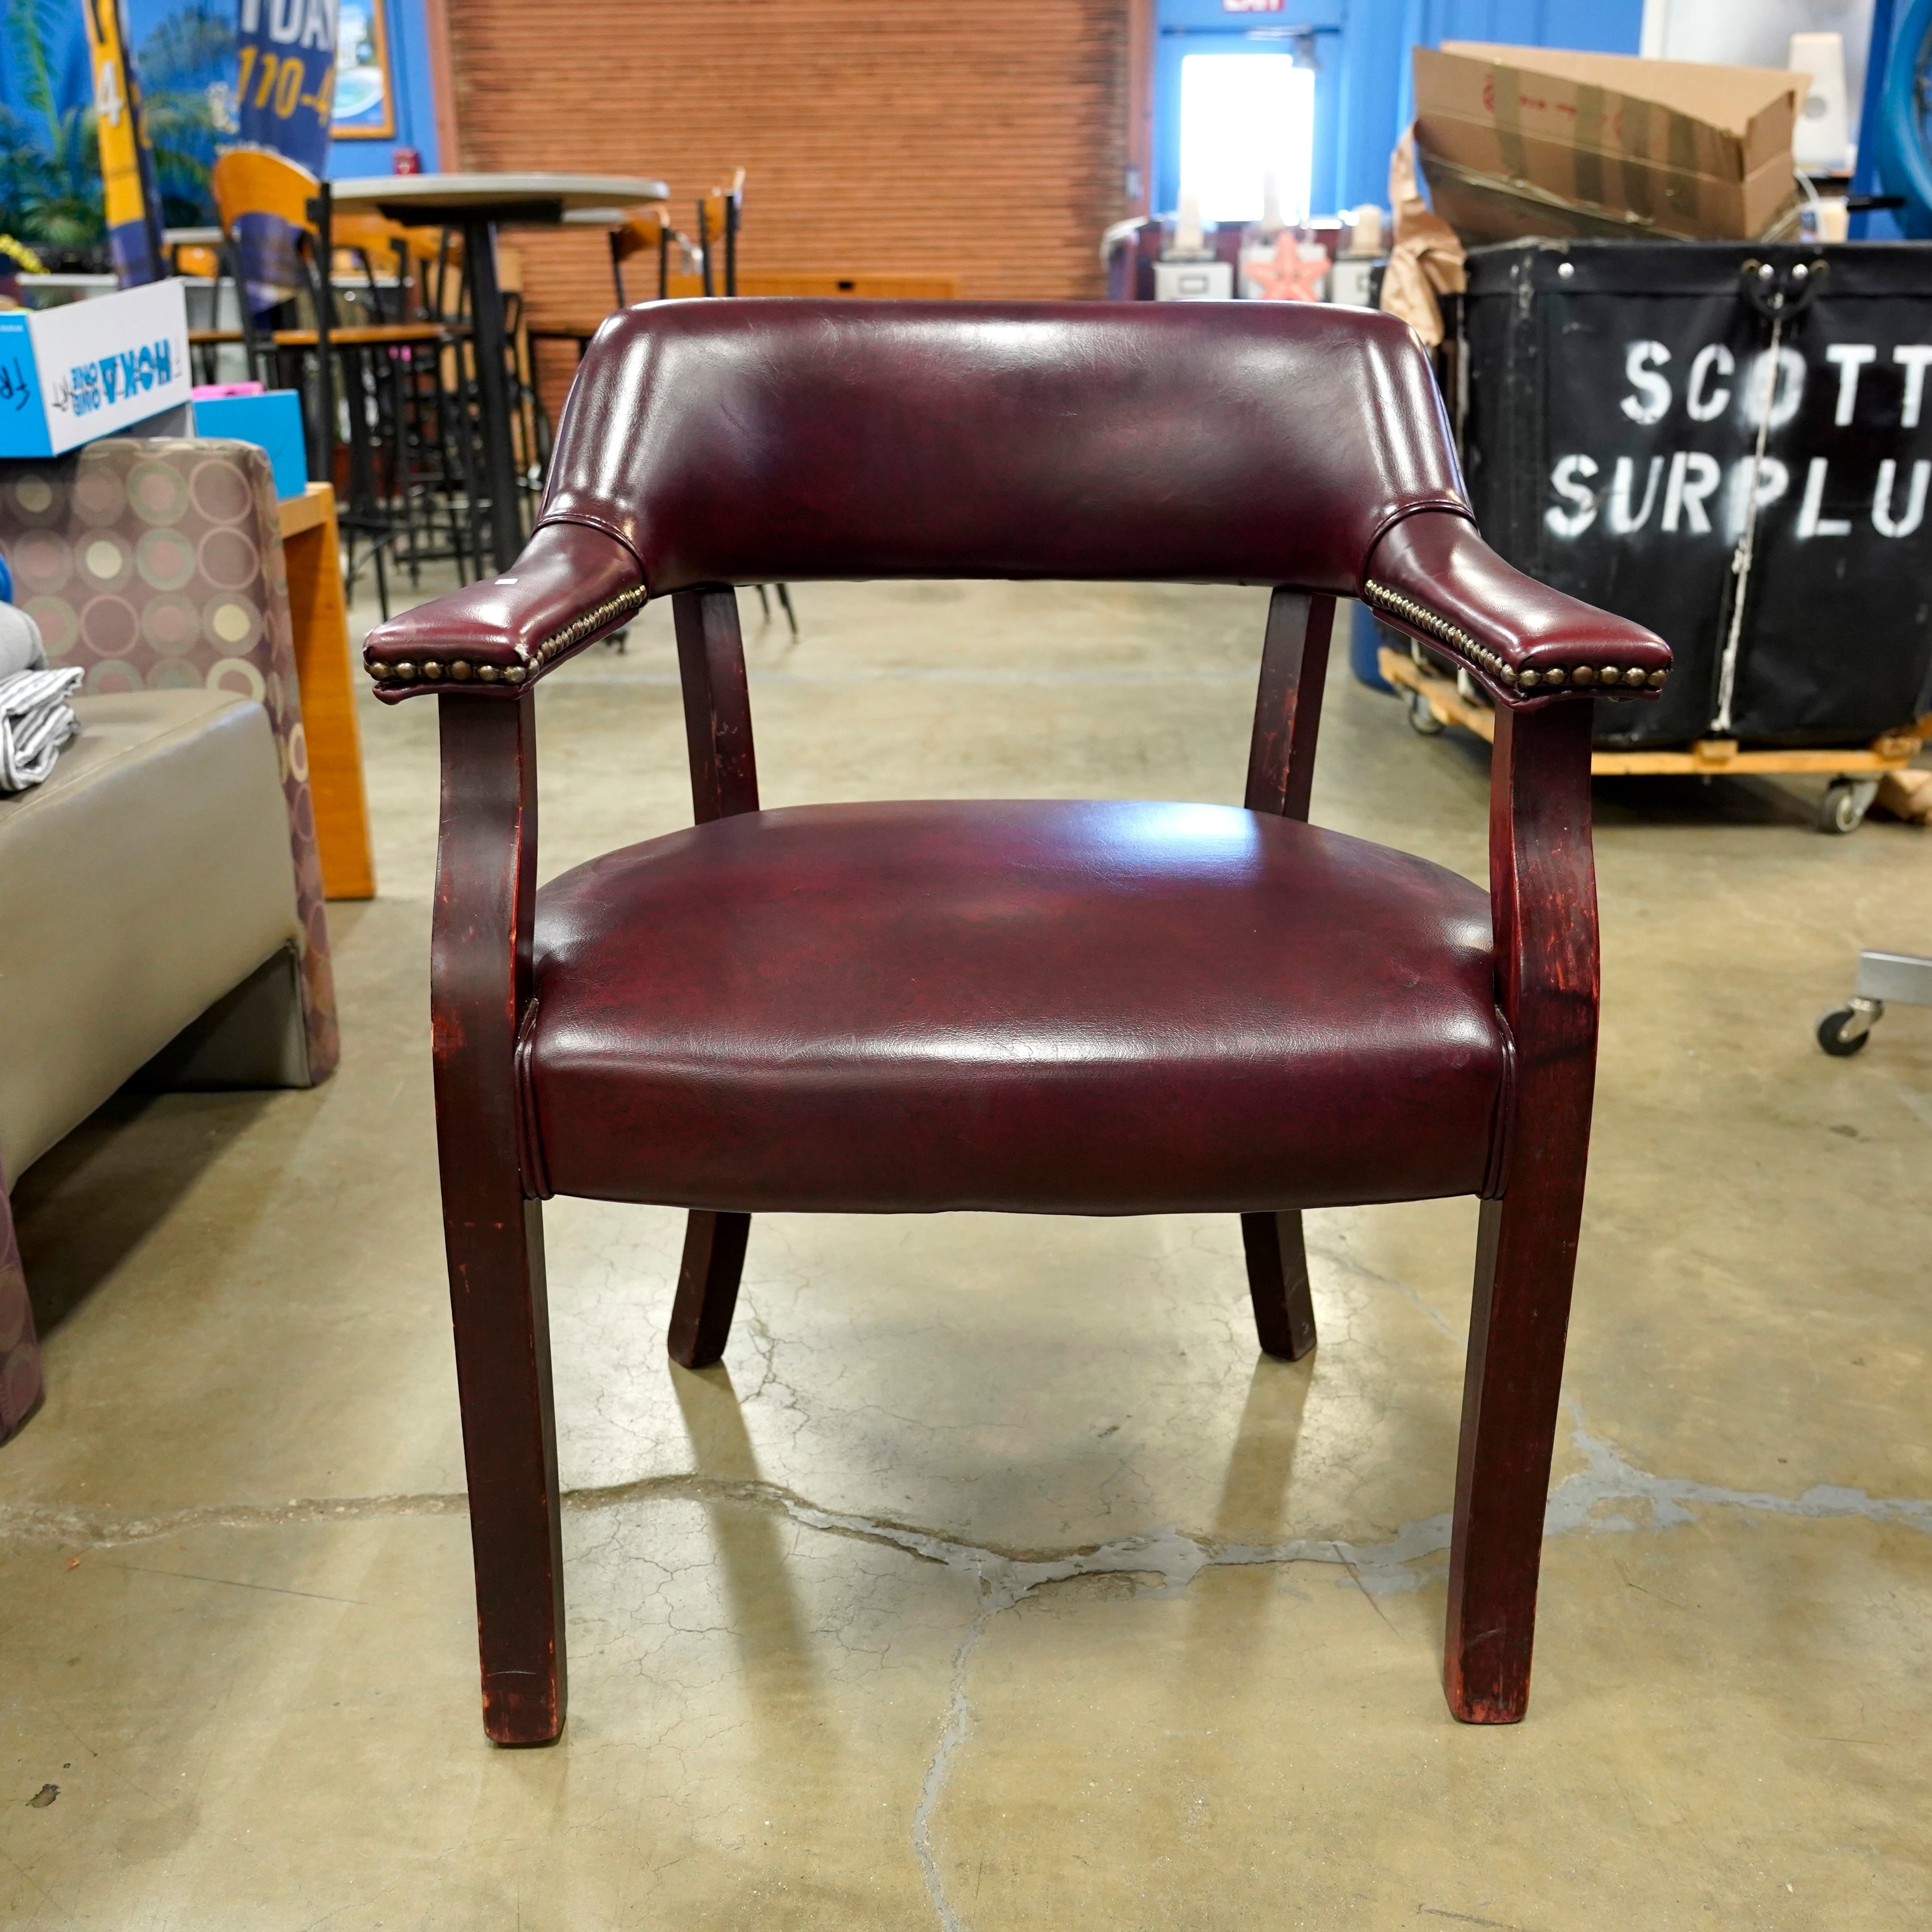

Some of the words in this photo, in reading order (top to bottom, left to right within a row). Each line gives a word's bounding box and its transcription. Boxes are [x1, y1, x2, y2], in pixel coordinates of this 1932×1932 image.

[98, 337, 172, 405] HOKA
[1619, 340, 1932, 429] SCOTT
[1545, 451, 1932, 542] SURPLU
